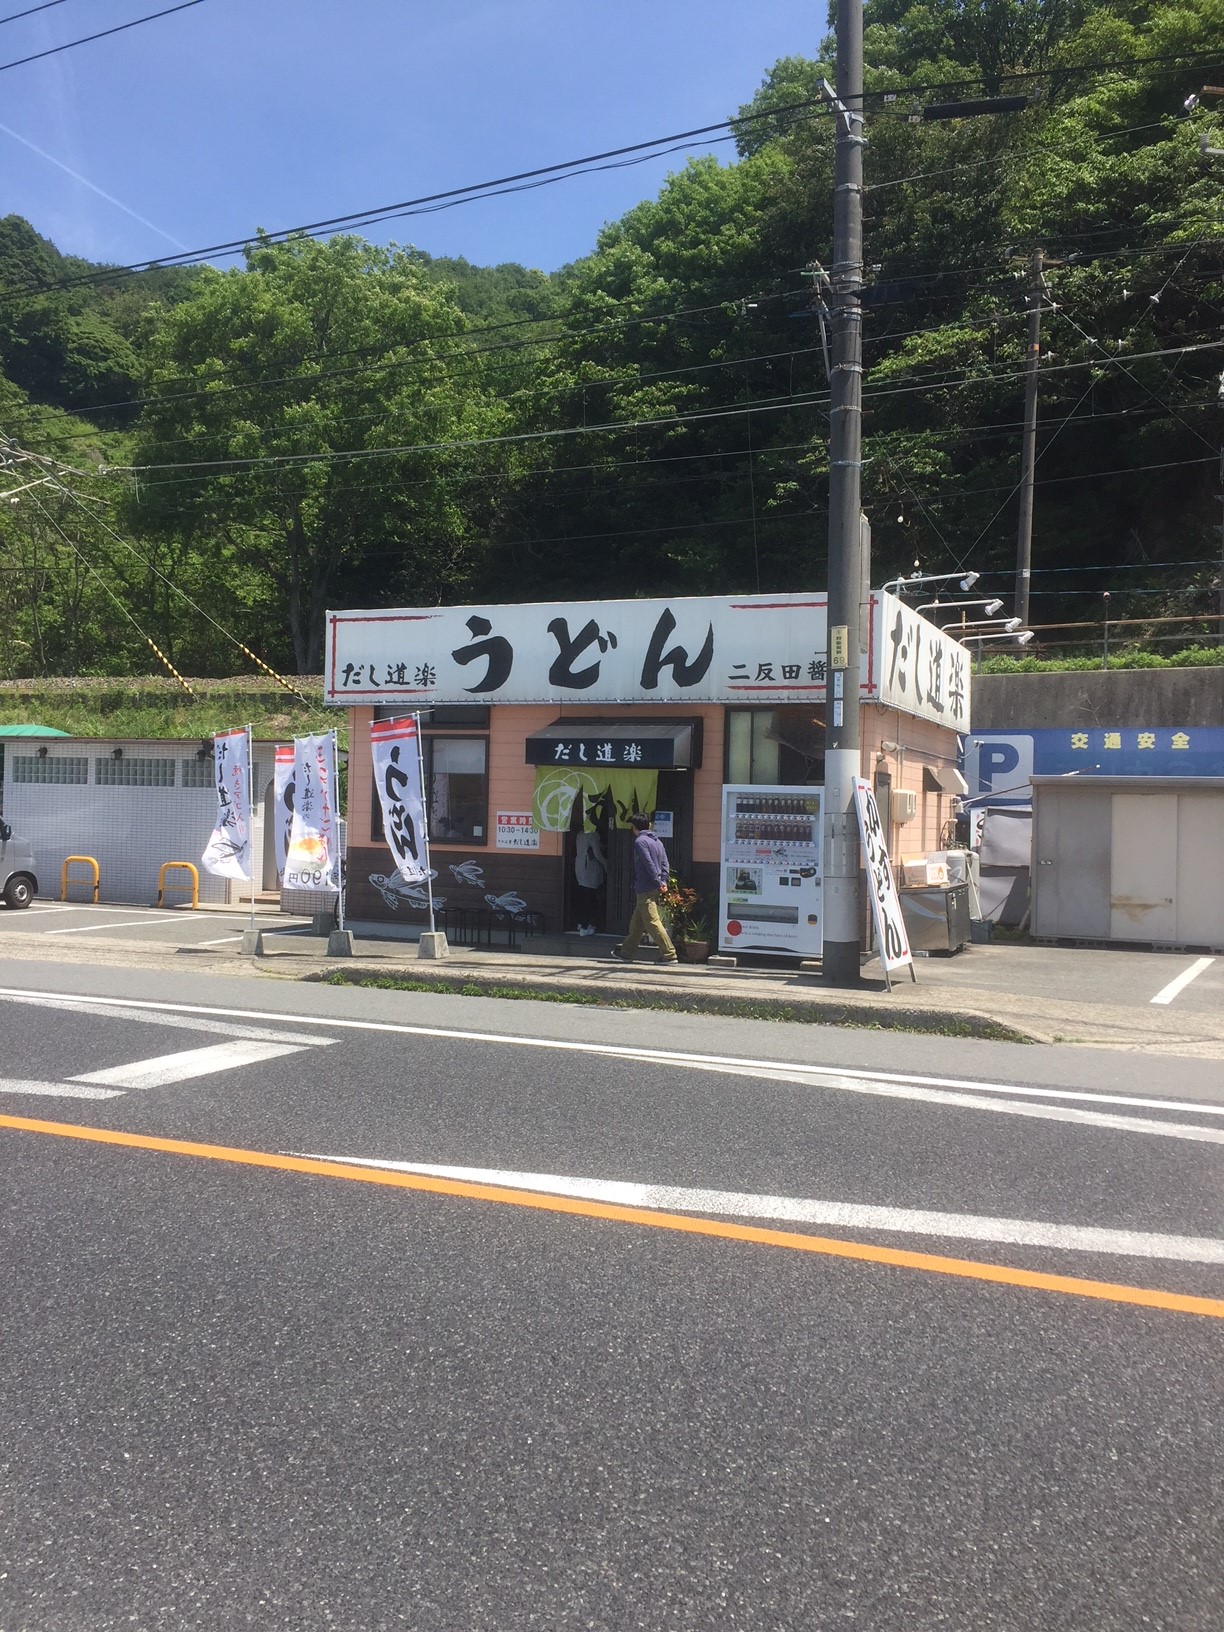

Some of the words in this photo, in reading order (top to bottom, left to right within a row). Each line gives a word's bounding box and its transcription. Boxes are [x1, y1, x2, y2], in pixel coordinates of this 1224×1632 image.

[451, 607, 714, 693] うどん
[889, 609, 965, 721] だし道楽
[342, 662, 437, 687] だし道楽
[555, 743, 642, 762] だし道楽
[1071, 731, 1190, 749] 交通安全
[978, 743, 1019, 792] P
